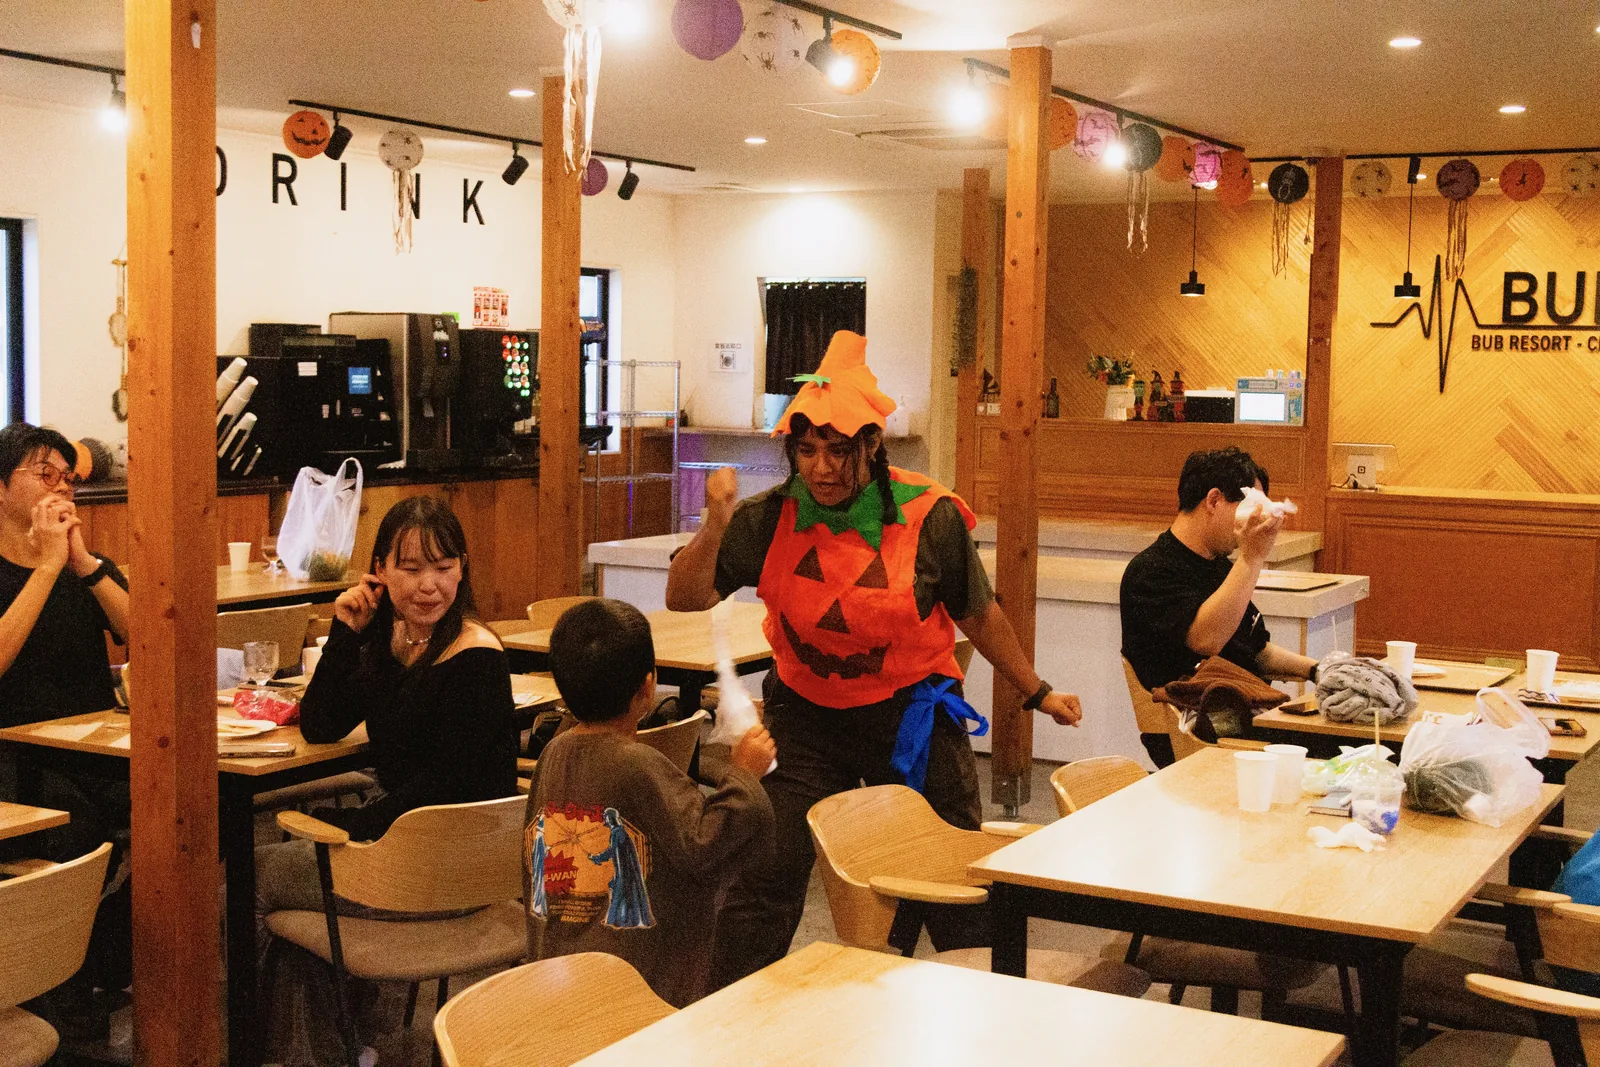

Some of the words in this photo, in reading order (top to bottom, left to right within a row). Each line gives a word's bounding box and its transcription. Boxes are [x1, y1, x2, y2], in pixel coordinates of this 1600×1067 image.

[1502, 271, 1600, 324] BU
[1471, 334, 1504, 351] BUB
[1509, 335, 1572, 352] RESORT
[1587, 336, 1600, 352] C
